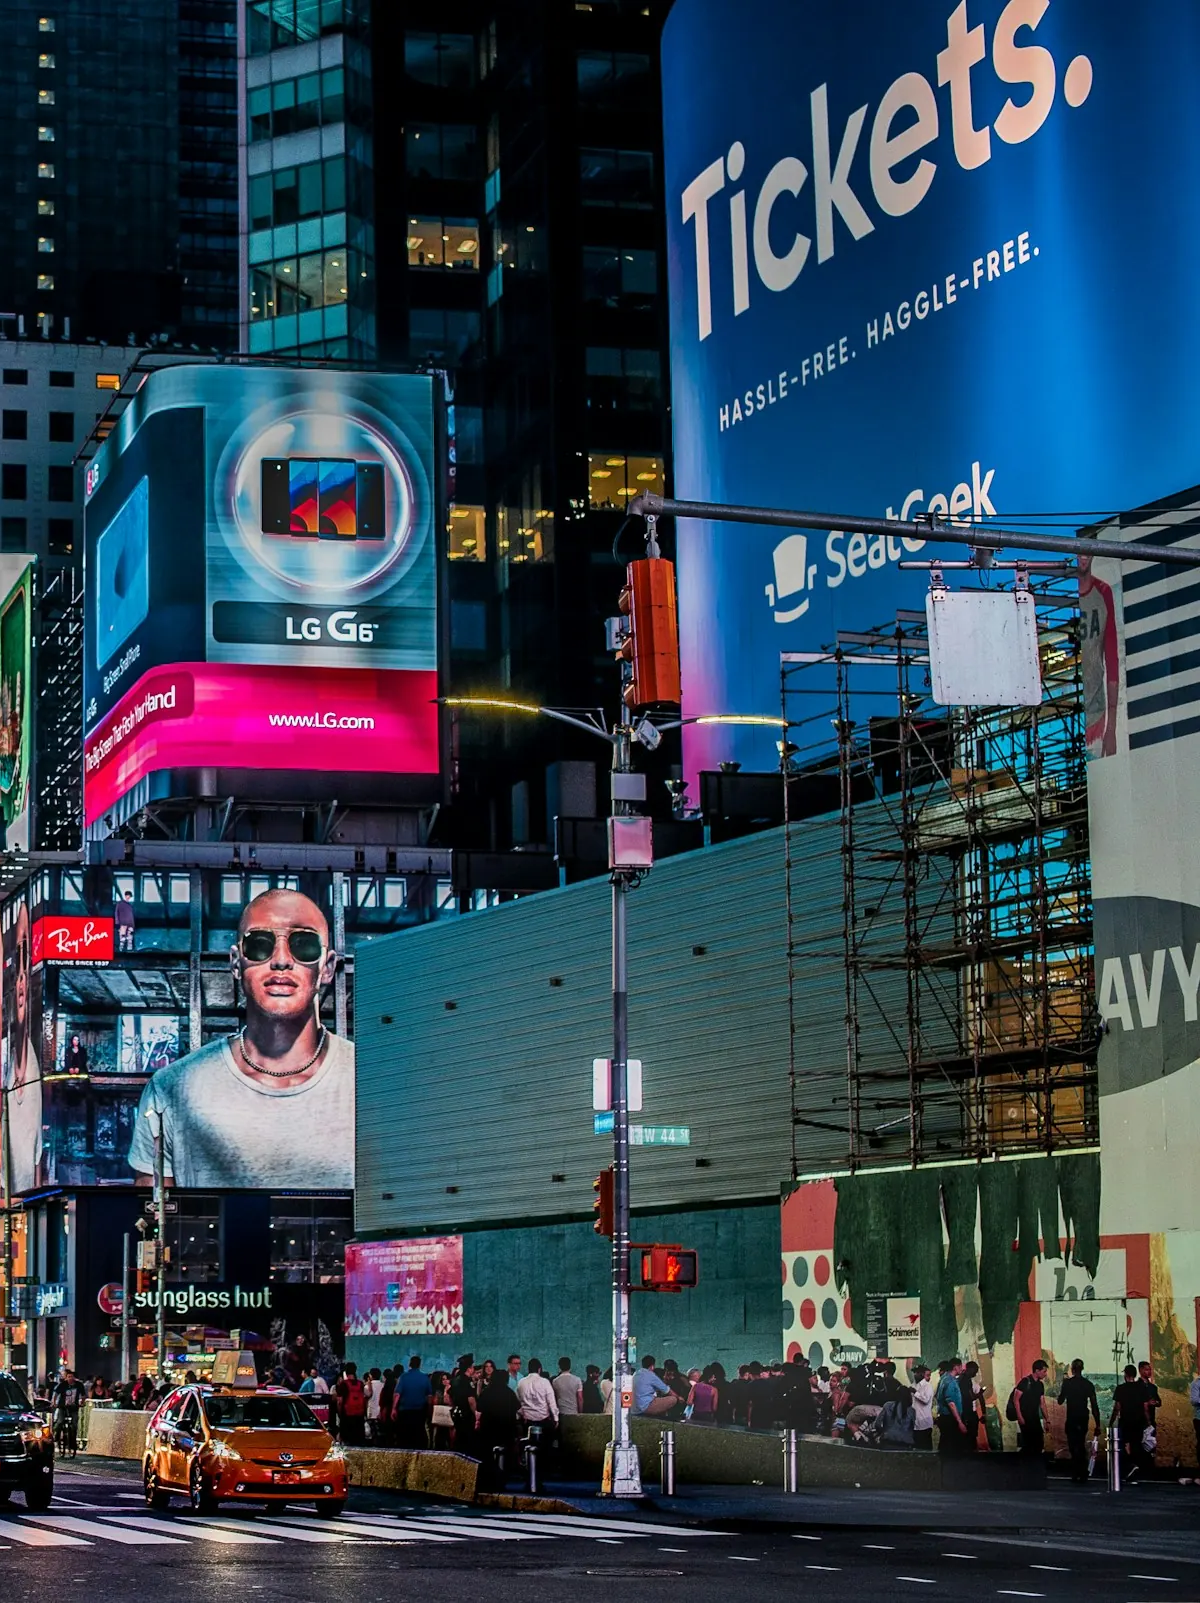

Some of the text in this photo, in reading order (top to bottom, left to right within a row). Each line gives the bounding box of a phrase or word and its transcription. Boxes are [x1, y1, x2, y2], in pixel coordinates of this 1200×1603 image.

[681, 0, 1093, 342] Tickets.
[719, 232, 1040, 432] HASSLE-FREE. HAGGLE-FREE.
[826, 461, 997, 588] SeatGeek
[286, 616, 320, 640] LG
[146, 684, 176, 714] Hand
[268, 712, 374, 730] www.LG.com
[644, 1129, 656, 1143] W
[660, 1128, 676, 1142] 44
[134, 1285, 272, 1314] sunglass hut
[888, 1327, 919, 1337] Schimenti
[846, 1352, 862, 1362] NAVY
